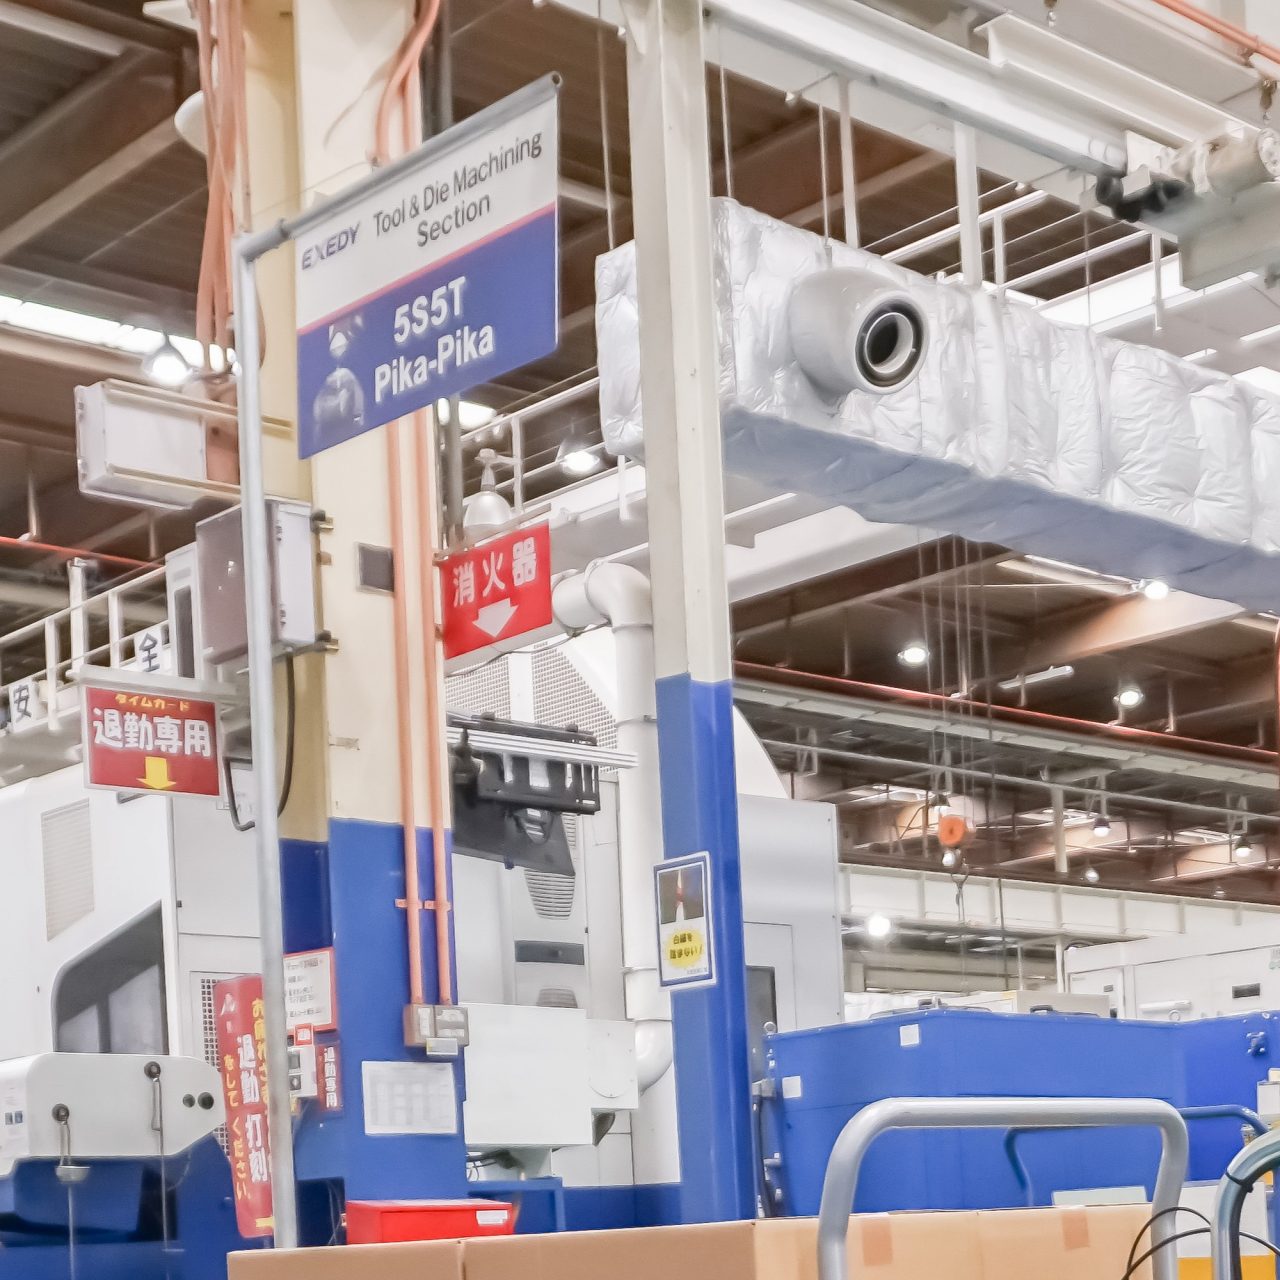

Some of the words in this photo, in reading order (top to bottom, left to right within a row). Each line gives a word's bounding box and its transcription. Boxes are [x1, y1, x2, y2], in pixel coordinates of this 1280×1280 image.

[302, 224, 360, 269] EXEDY
[373, 206, 405, 236] Tool
[409, 194, 420, 219] &
[423, 181, 449, 212] Die
[453, 132, 542, 194] Machining
[417, 194, 490, 247] Section
[394, 276, 465, 344] 5S5T
[374, 323, 495, 403] Pika-Pika
[453, 537, 537, 608] 消火器
[14, 684, 32, 719] 安
[139, 632, 161, 672] 全
[115, 693, 191, 712] タイムカード
[93, 707, 211, 757] 退勤専用
